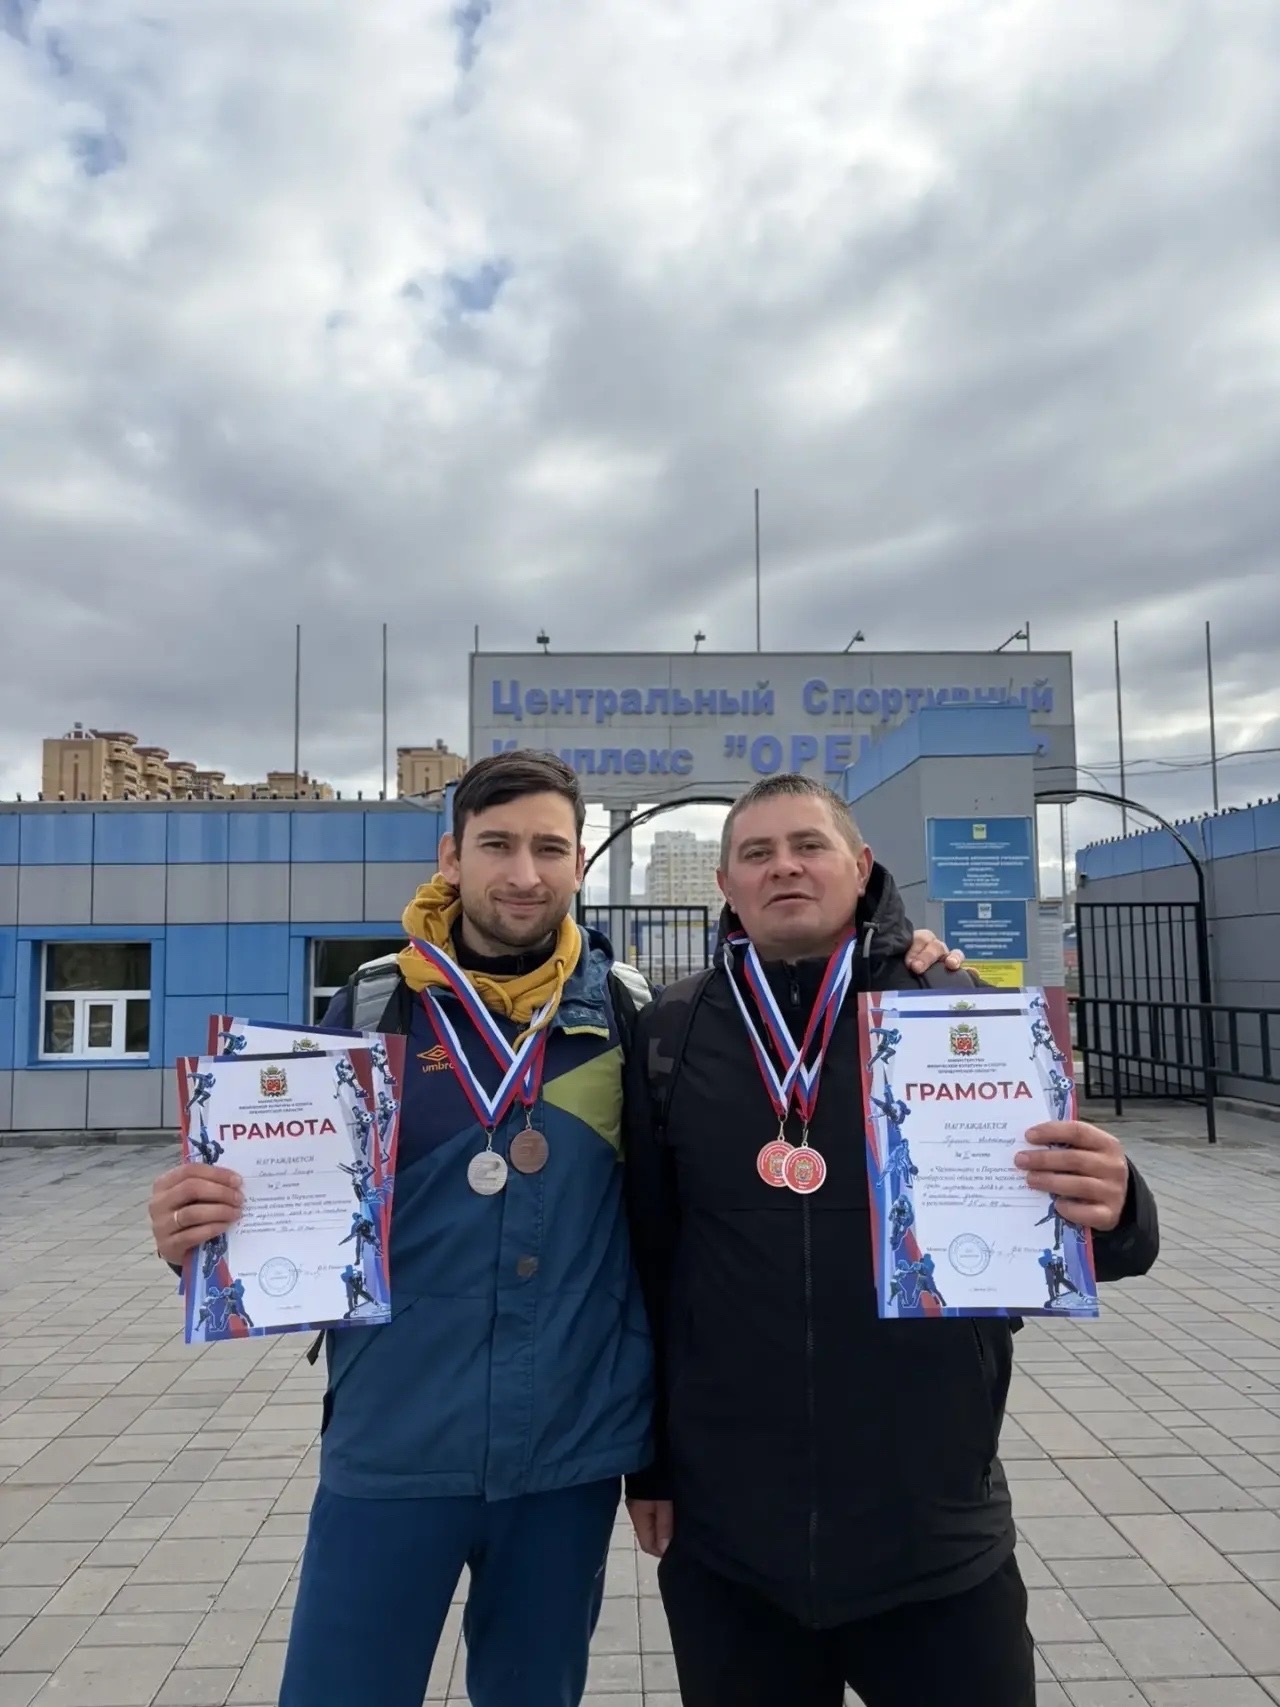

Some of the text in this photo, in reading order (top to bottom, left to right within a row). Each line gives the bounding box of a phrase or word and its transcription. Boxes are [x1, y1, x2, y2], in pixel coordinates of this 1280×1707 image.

[492, 679, 776, 724] Центральный
[492, 738, 694, 776] плекс
[905, 1081, 1033, 1102] ГРАМОТА
[219, 1118, 337, 1141] ГРАМОТА
[944, 1122, 1008, 1130] НАГРАЖДАЕТСЯ
